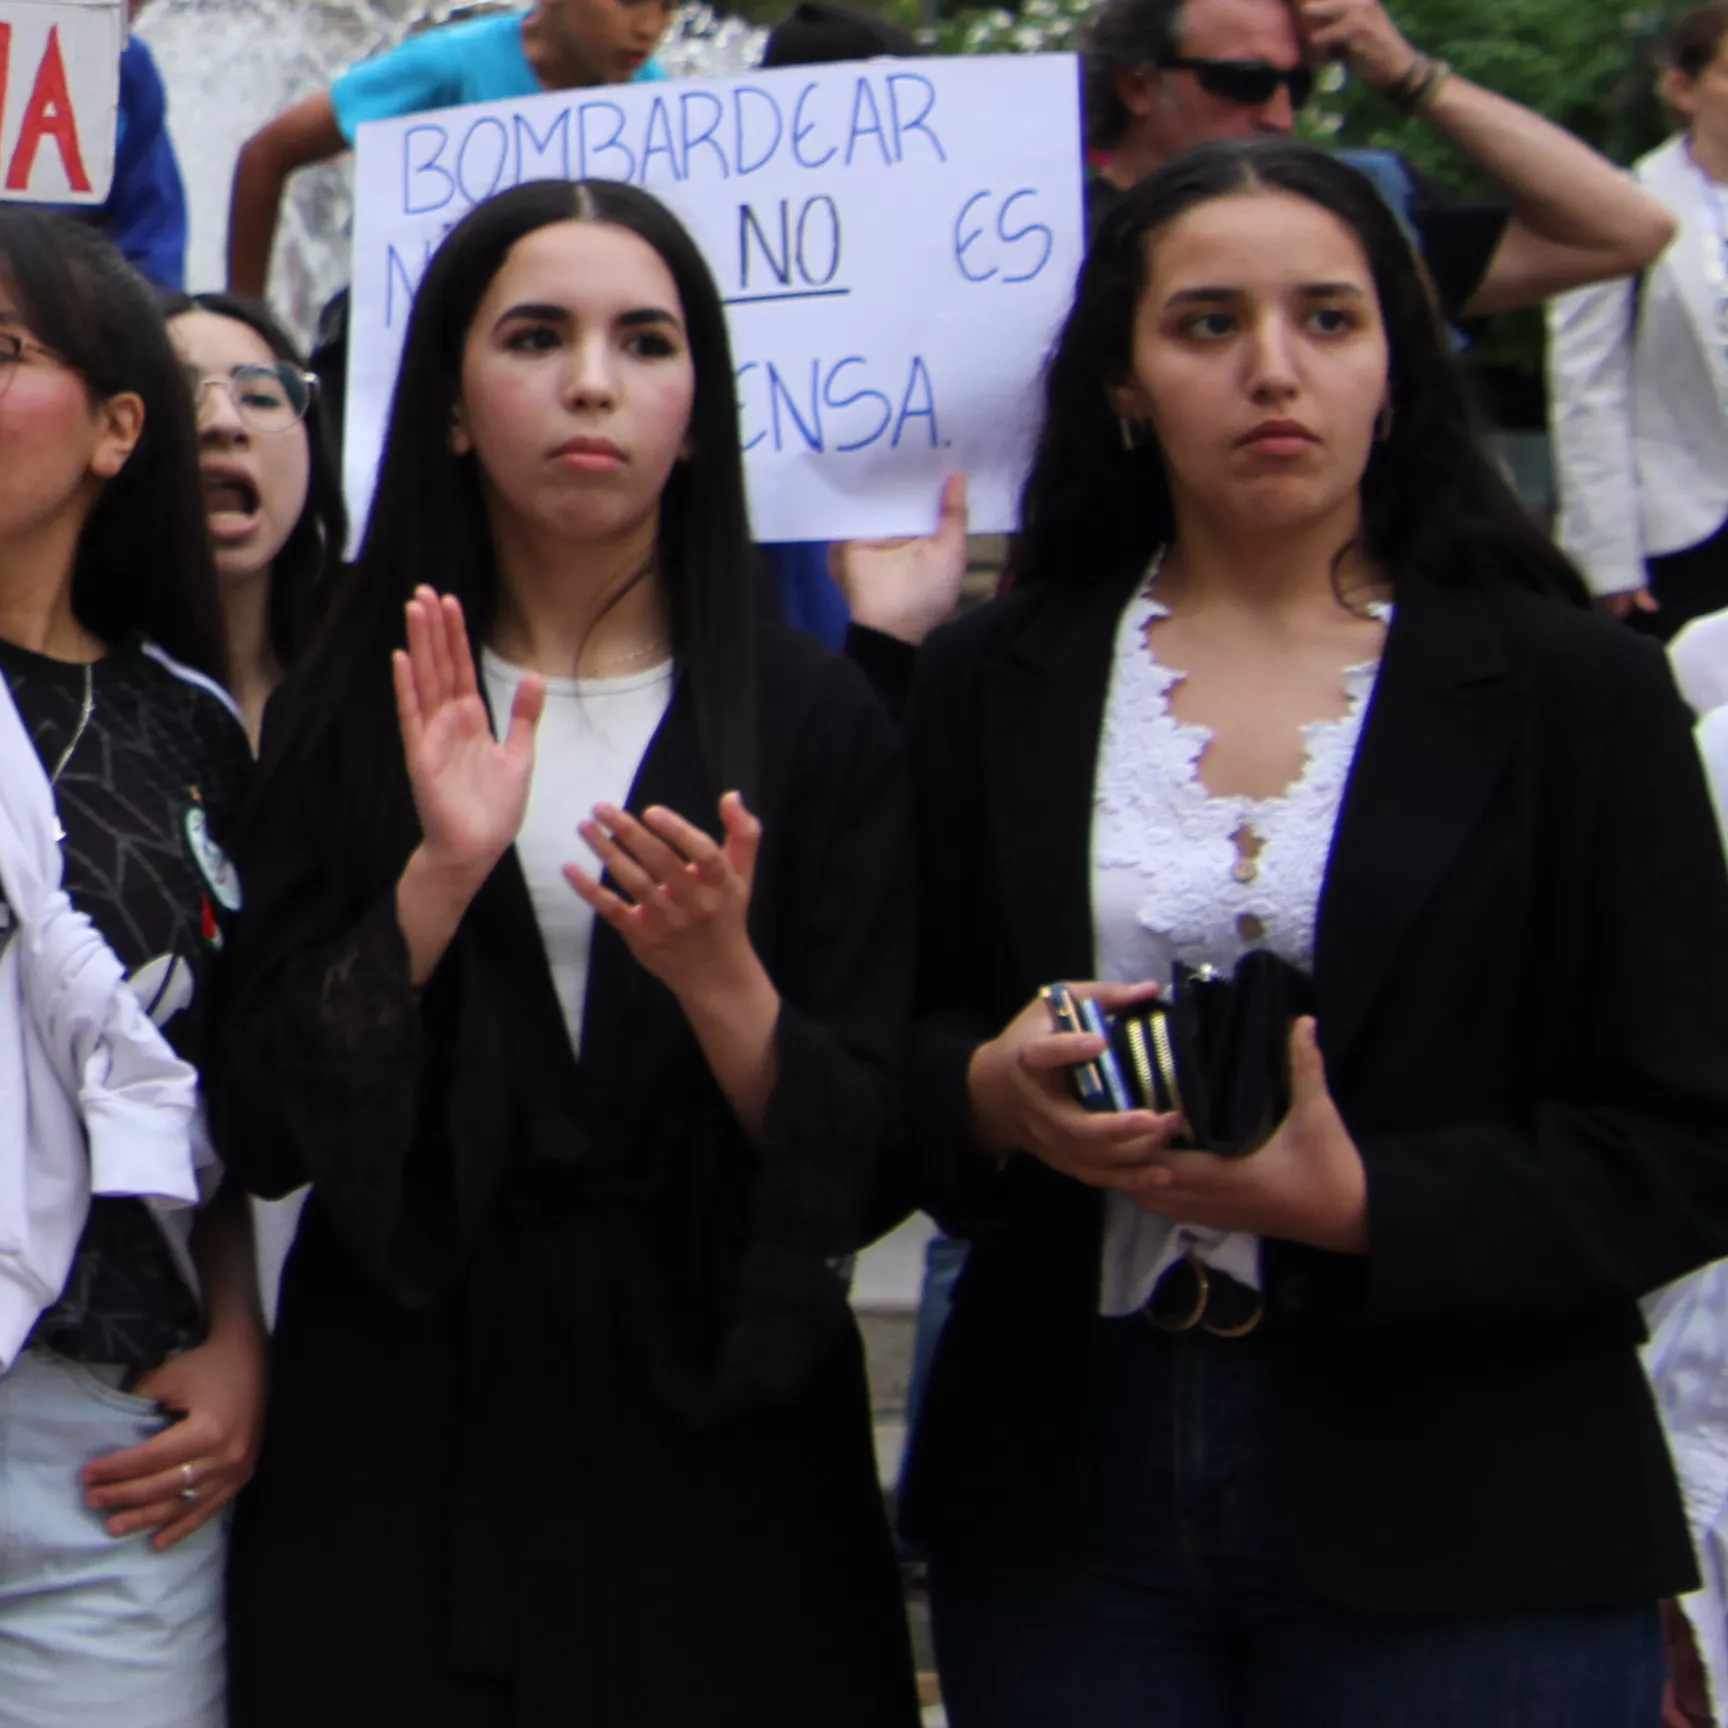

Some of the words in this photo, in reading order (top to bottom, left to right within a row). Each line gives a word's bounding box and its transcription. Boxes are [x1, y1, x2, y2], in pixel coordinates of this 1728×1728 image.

[402, 72, 948, 216] BOMBARDEAR
[739, 193, 842, 289] NO
[953, 188, 1054, 284] ES
